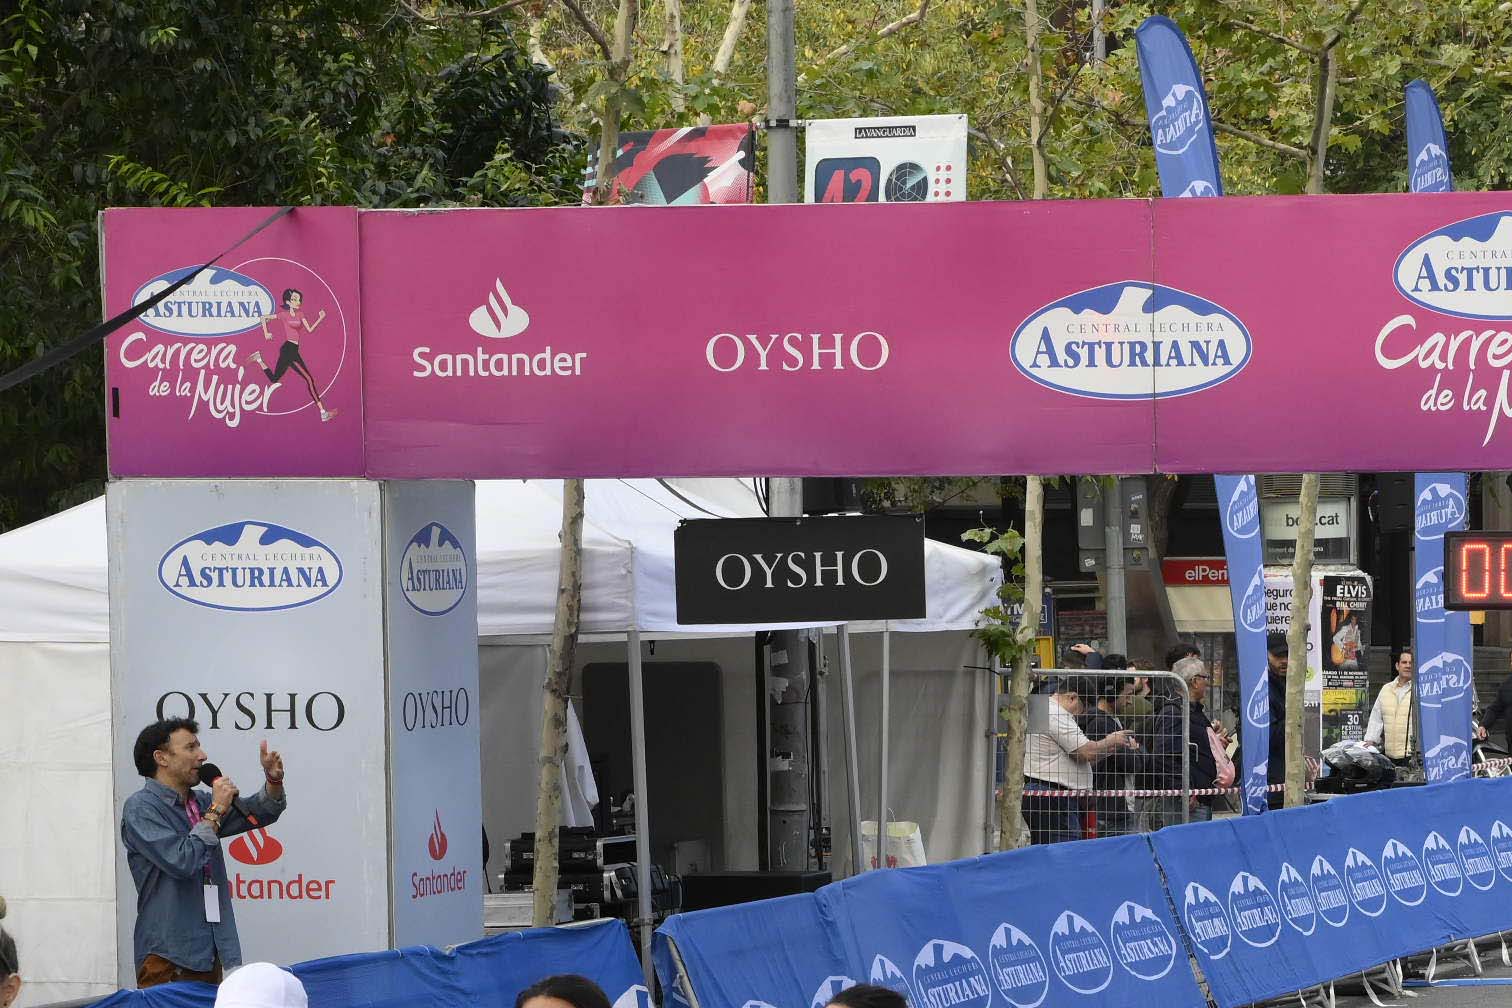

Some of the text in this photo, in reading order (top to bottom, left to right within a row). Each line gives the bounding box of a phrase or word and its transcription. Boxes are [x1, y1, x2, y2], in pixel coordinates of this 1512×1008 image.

[1066, 322, 1224, 334] CENTRAL LECHERA
[119, 332, 238, 370] Carrera
[413, 346, 587, 377] Santander
[706, 331, 889, 372] OYSHO
[1029, 326, 1233, 369] ASTURIANA
[148, 366, 283, 428] de la Mujer
[1420, 372, 1455, 411] de
[1463, 368, 1488, 411] la
[174, 554, 329, 590] ASTURIANA
[200, 552, 322, 562] CENTRAL LECHERA
[715, 548, 888, 590] OYSHO
[1185, 565, 1228, 581] elPeri
[406, 560, 464, 592] ASTURIANA
[1336, 585, 1366, 598] ELVIS
[156, 691, 345, 732] OYSHO
[403, 688, 469, 732] OYSHO
[1347, 714, 1359, 724] 30
[228, 873, 336, 900] tander
[412, 866, 468, 900] Santander
[995, 958, 1045, 990] ASTURIANA
[1056, 944, 1109, 978] ASTURIANA
